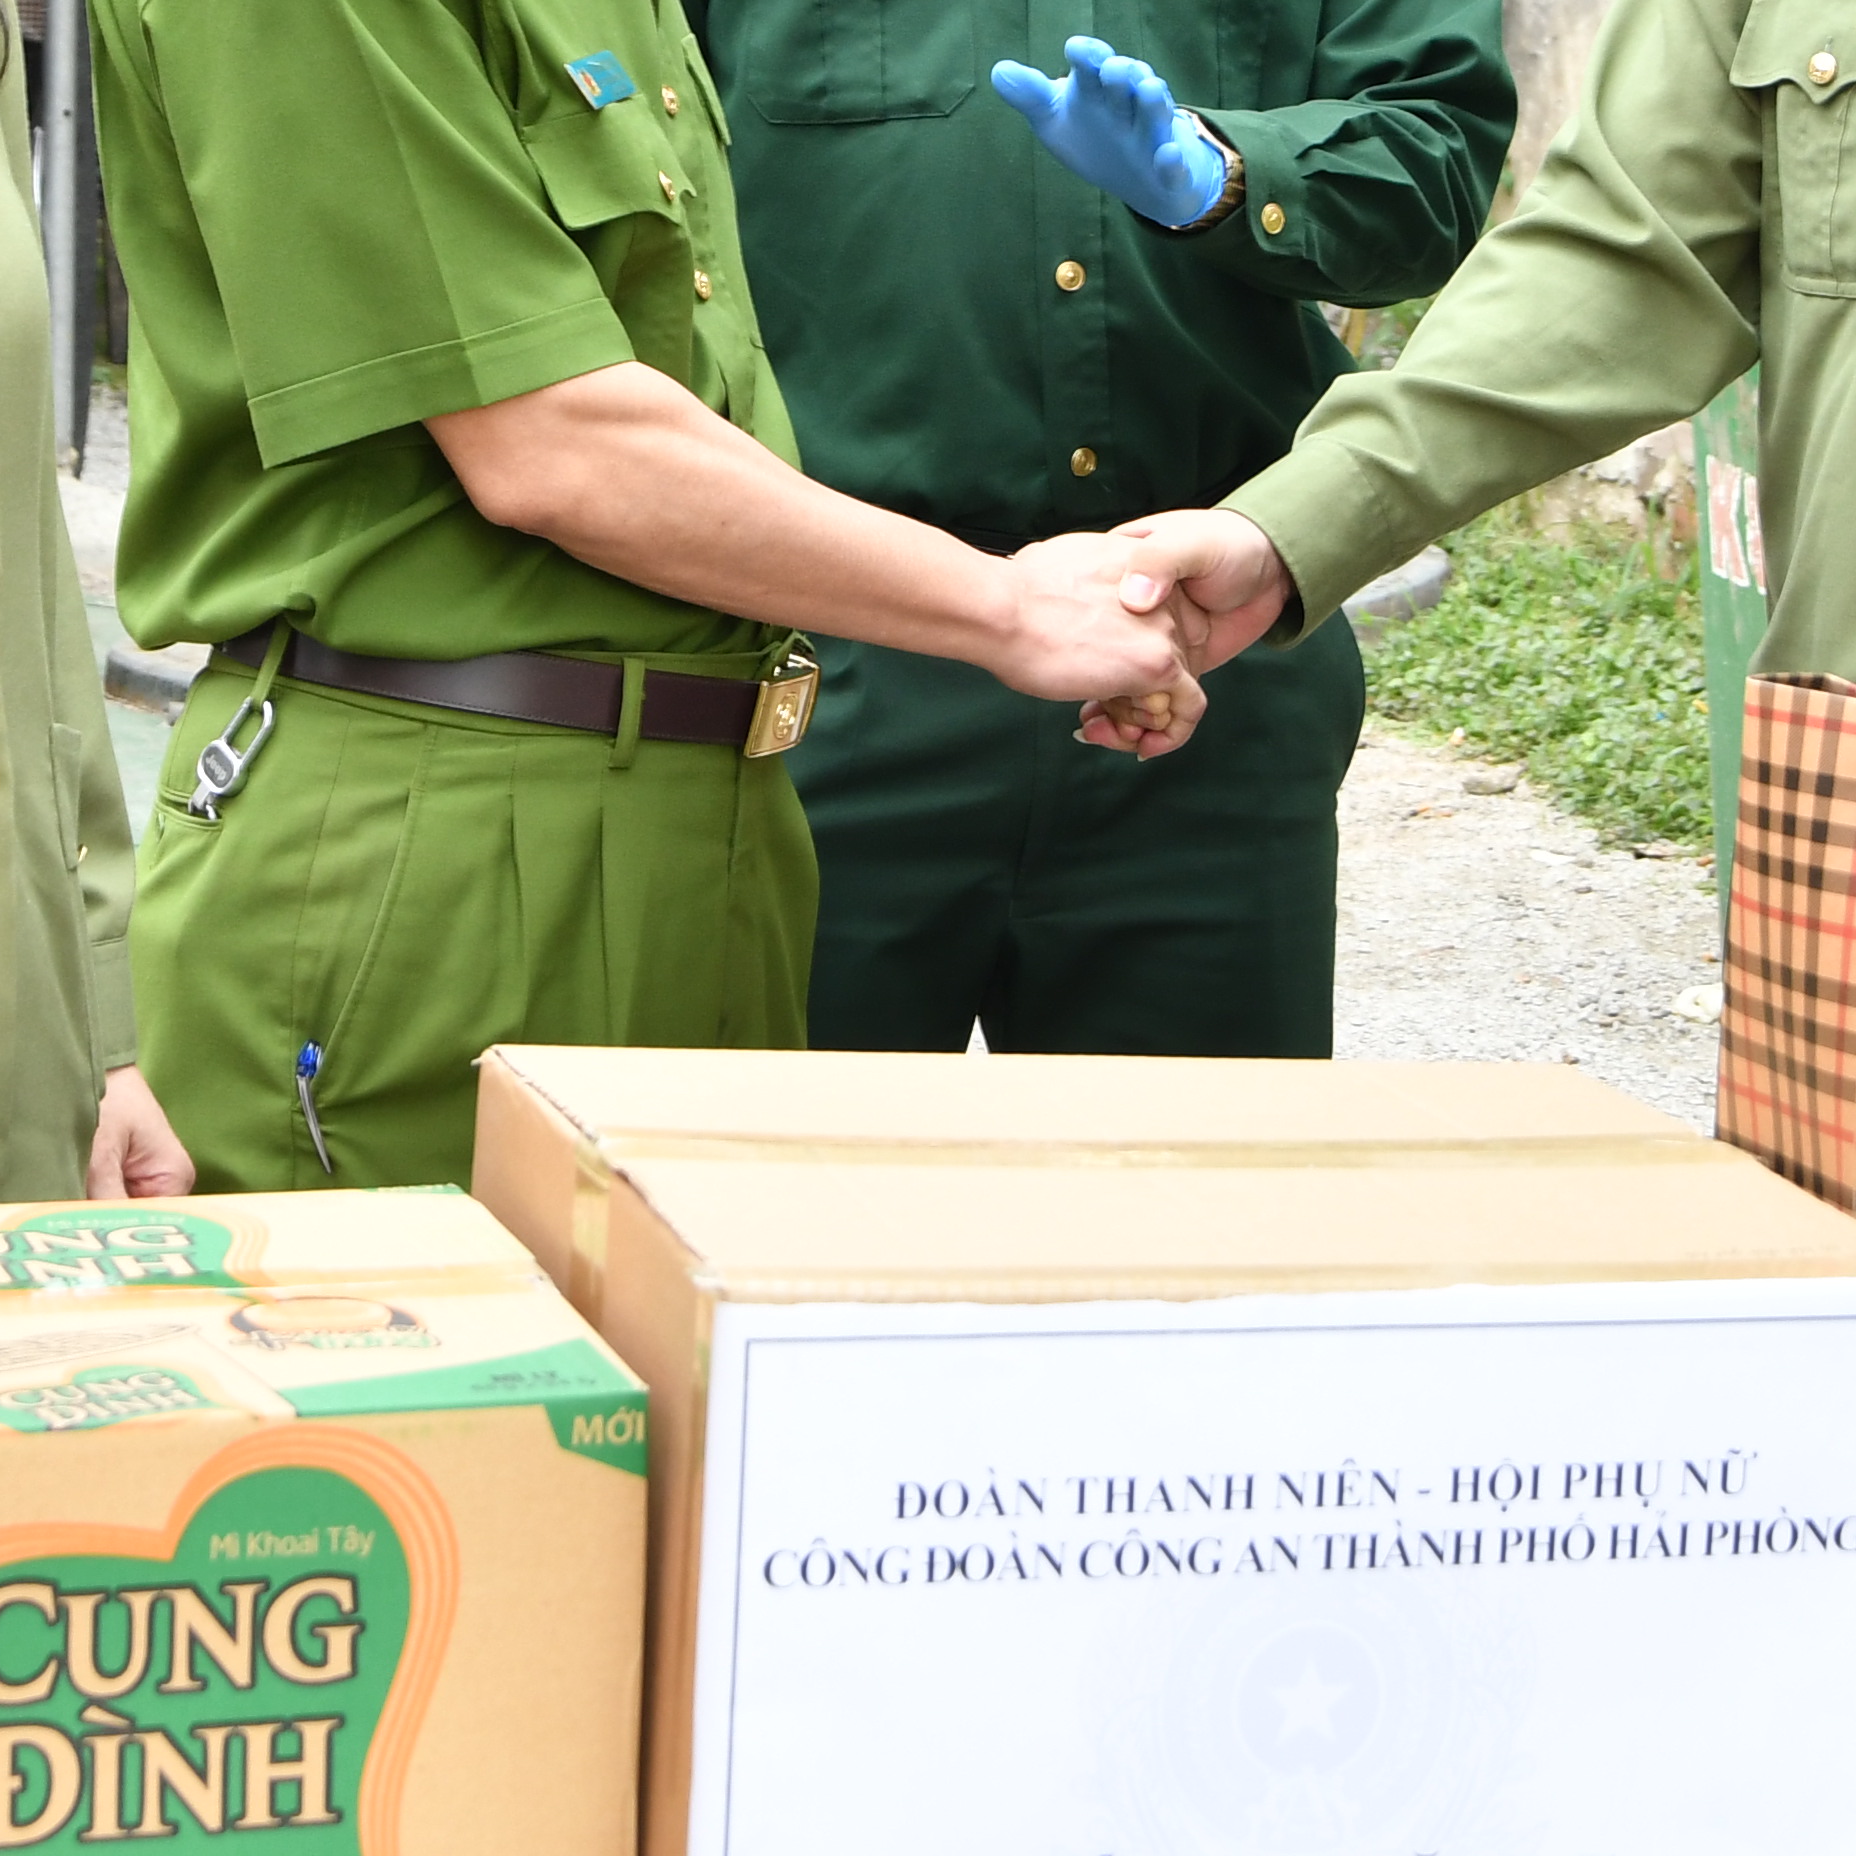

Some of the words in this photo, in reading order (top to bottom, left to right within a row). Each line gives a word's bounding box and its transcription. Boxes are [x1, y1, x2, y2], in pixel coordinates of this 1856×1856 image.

[570, 1405, 647, 1446] MỚI
[895, 1467, 1046, 1521] ĐOÀN
[1066, 1473, 1255, 1516] THANH
[1276, 1458, 1399, 1509] NIÊN
[1449, 1458, 1541, 1514] HỘI
[1562, 1460, 1666, 1512] PHỤ
[1681, 1448, 1758, 1497] NỮ
[247, 1528, 319, 1557] Khoai
[327, 1525, 377, 1558] Tây
[762, 1537, 910, 1590] CÔNG
[925, 1531, 1065, 1584] ĐOÀN
[1078, 1528, 1222, 1579] CÔNG
[1234, 1535, 1301, 1575] AN
[1313, 1519, 1483, 1572] THÀNH
[1497, 1510, 1597, 1565] PHỐ
[1608, 1511, 1690, 1561] HẢI
